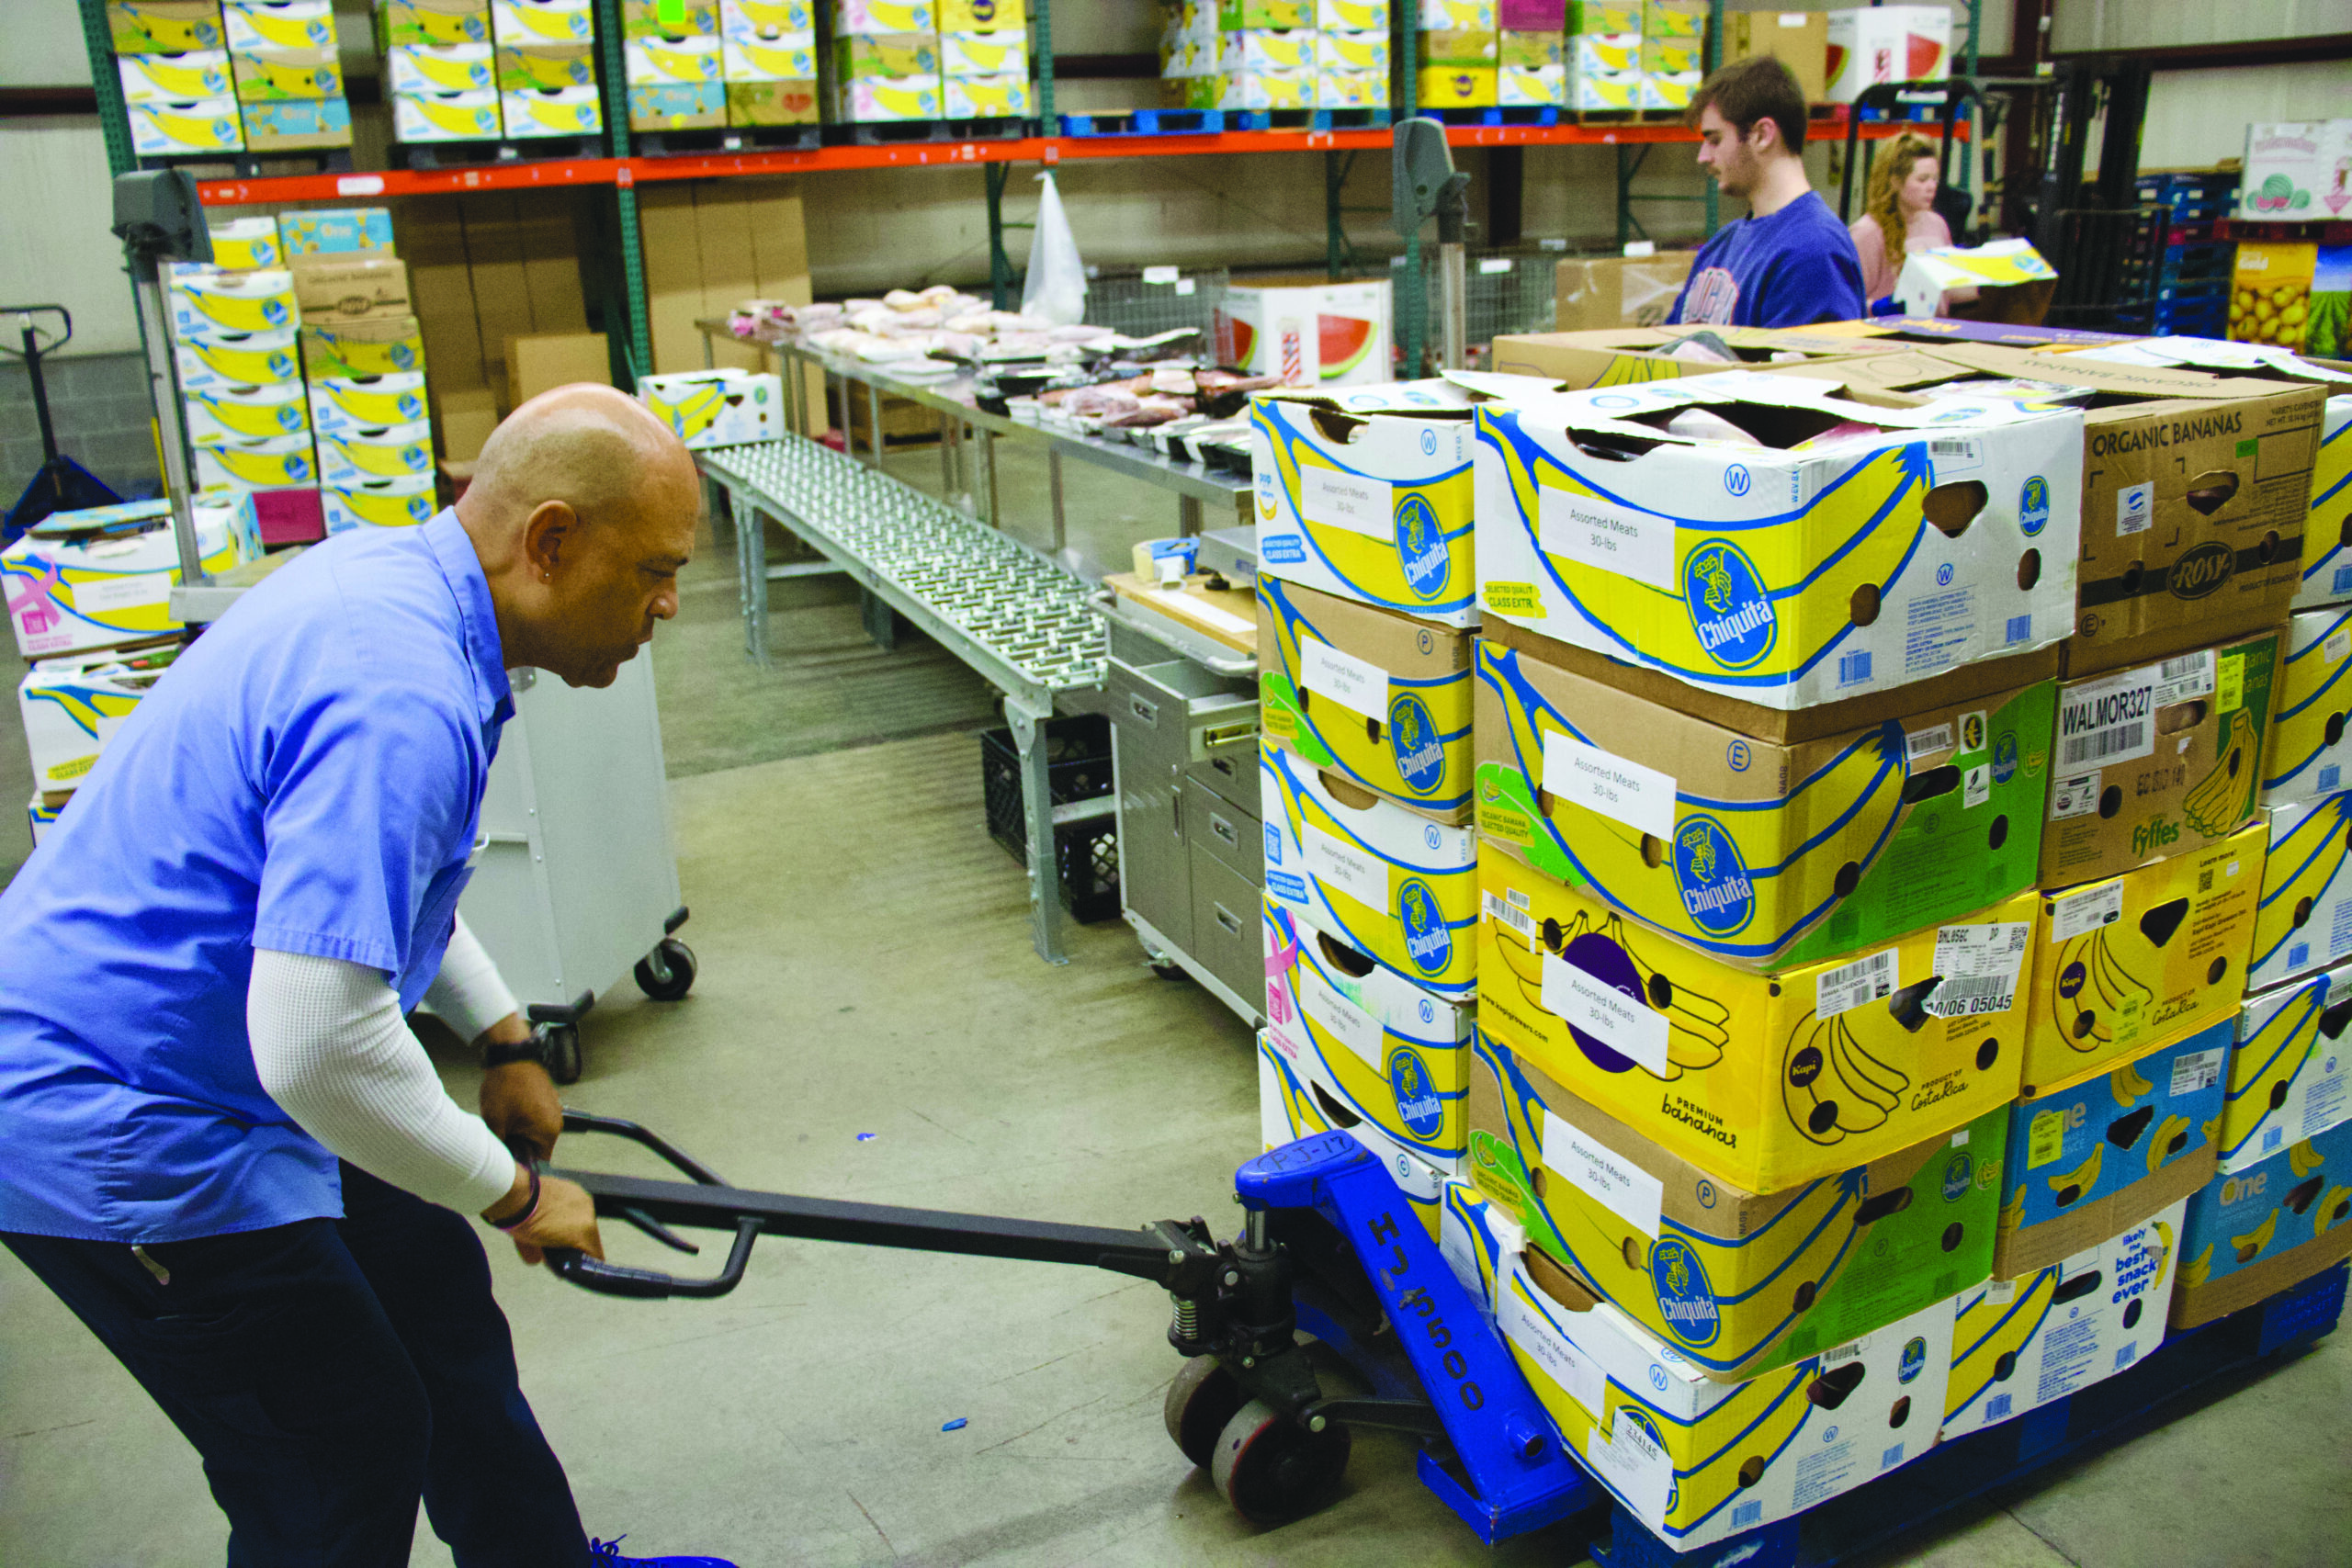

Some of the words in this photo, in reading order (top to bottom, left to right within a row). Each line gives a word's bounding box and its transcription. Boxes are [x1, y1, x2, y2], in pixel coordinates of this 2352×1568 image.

[2020, 358, 2115, 379] BANANAS
[2092, 424, 2168, 457] ORGANIC
[2173, 412, 2243, 444] BANANAS
[1322, 482, 1348, 498] Assorted
[1349, 490, 1369, 501] Meats
[1570, 509, 1608, 530] Assorted
[1610, 519, 1638, 537] Meats
[2021, 508, 2048, 525] Chiquita
[1589, 534, 1617, 552] 30-lbs
[1404, 541, 1449, 585] Chiquita
[2173, 548, 2231, 590] ROSY
[1488, 597, 1510, 608] CLASS
[1696, 599, 1775, 651] Chiquita
[1320, 657, 1346, 675] Assorted
[1347, 668, 1365, 684] Meats
[2244, 647, 2272, 674] ganic
[2063, 685, 2153, 736] WALMOR327
[1397, 741, 1442, 779] Chiquita
[1574, 757, 1611, 782] Assorted
[1612, 772, 1641, 793] Meats
[1592, 783, 1619, 803] 30-lbs
[1778, 765, 1788, 795] NA08
[1321, 843, 1346, 863] Assorted
[1346, 857, 1365, 874] Meats
[1682, 874, 1753, 916] Chiquita
[1407, 927, 1451, 959] Chiquita
[1571, 979, 1607, 1008] Assorted
[1608, 999, 1635, 1023] Meats
[1926, 998, 1967, 1017] 0/06
[1970, 994, 2013, 1014] 05045
[1588, 1007, 1615, 1030] 30-lbs
[1792, 1060, 1817, 1077] Kapi
[1921, 1073, 1953, 1090] PRODUCT
[1953, 1069, 1962, 1078] OF
[1397, 1095, 1442, 1122] Chiquita
[1661, 1092, 1737, 1149] bananas
[1677, 1097, 1724, 1127] PREMIUM
[1571, 1141, 1606, 1173] Assorted
[1606, 1162, 1631, 1187] Meats
[1587, 1169, 1611, 1191] 30-lbs
[2219, 1172, 2267, 1206] One
[1739, 1211, 1747, 1235] NA08
[1366, 1211, 1408, 1276] HJ
[2115, 1246, 2148, 1273] best
[2117, 1257, 2158, 1287] snack
[2111, 1278, 2150, 1304] ever
[1659, 1296, 1718, 1326] Chiquita
[1521, 1314, 1553, 1347] Assorted
[1552, 1338, 1576, 1368] Meats
[1535, 1344, 1558, 1368] 30-lbs
[1626, 1424, 1657, 1457] 234145
